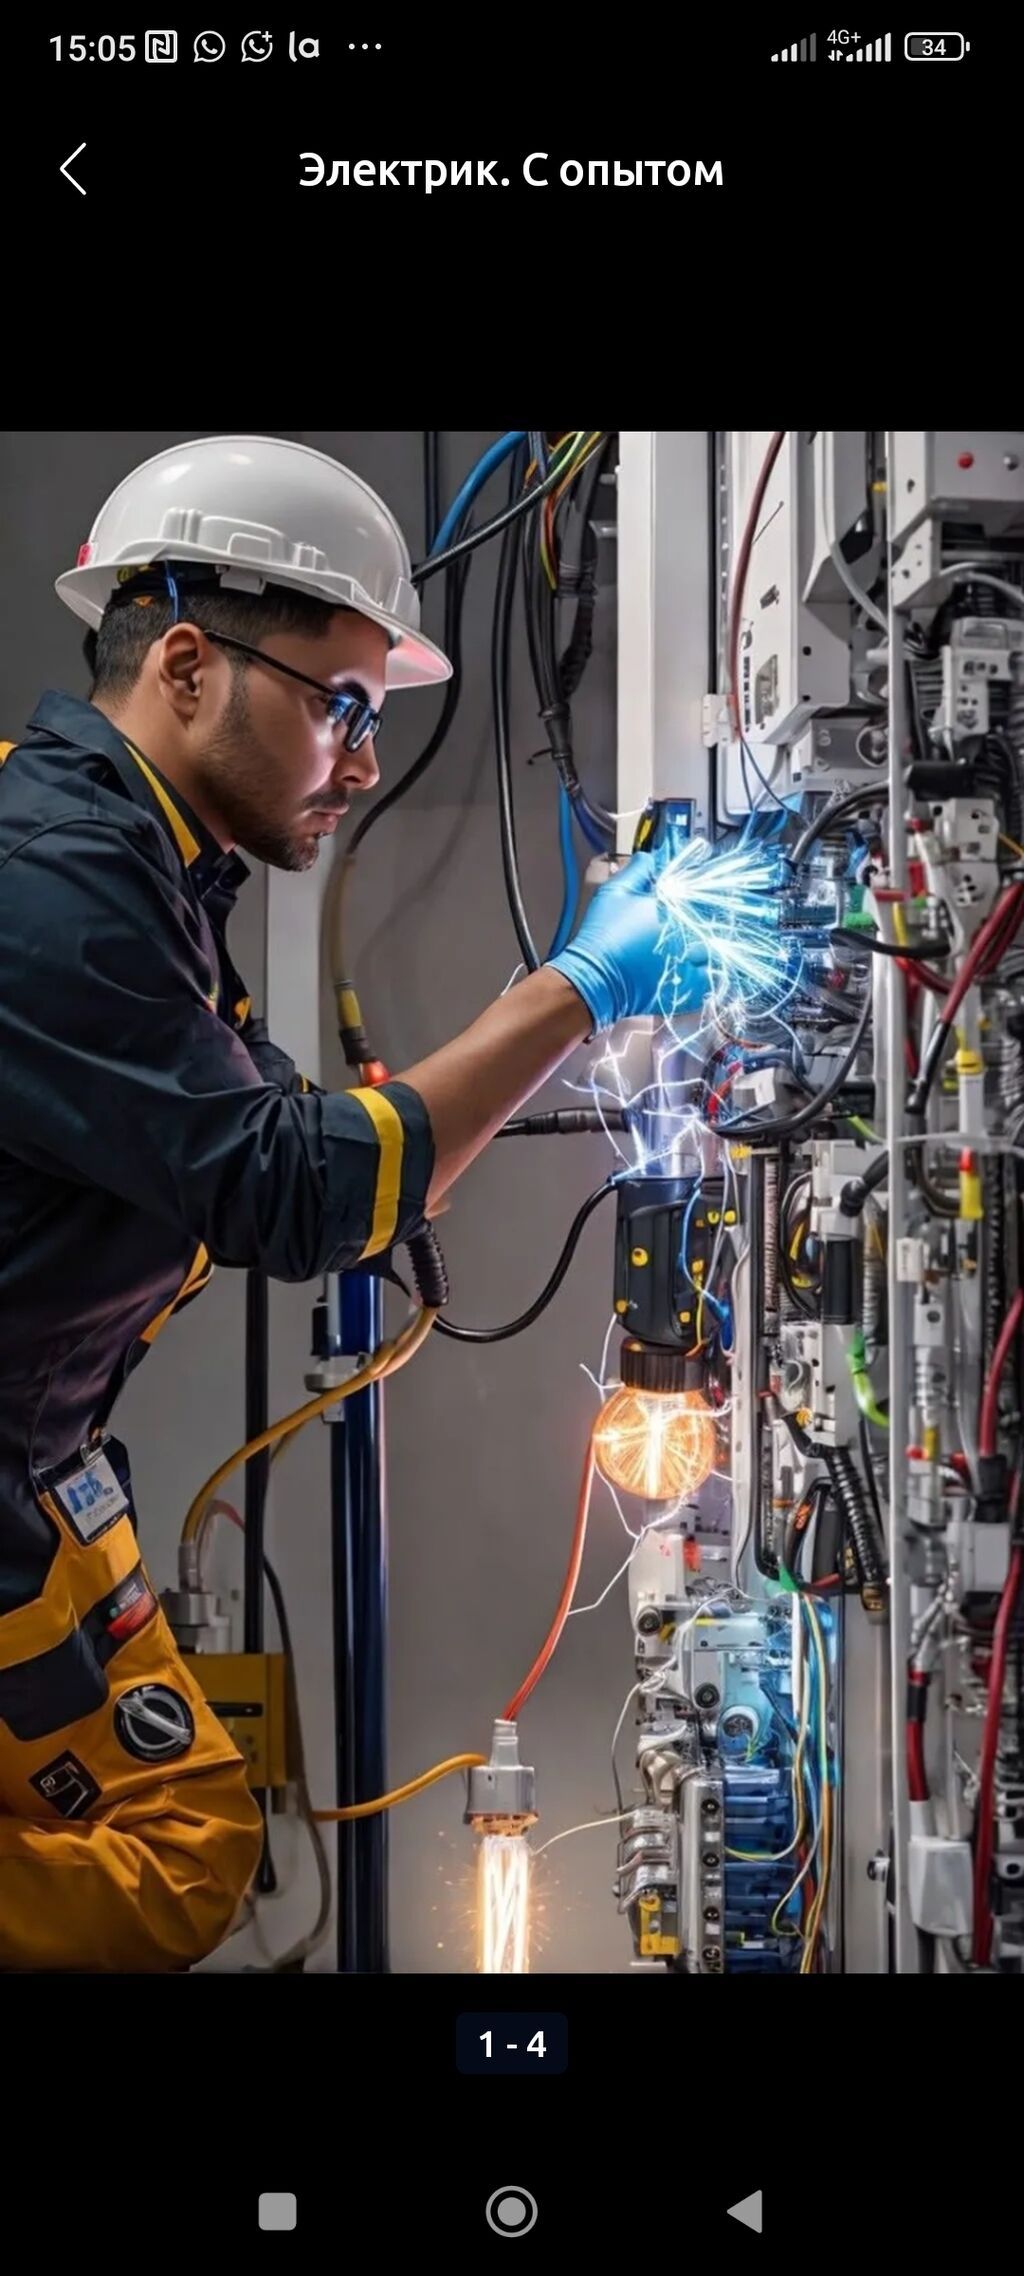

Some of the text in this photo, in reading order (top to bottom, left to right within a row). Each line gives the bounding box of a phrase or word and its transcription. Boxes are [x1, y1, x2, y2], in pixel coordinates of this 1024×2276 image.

[49, 34, 136, 62] 15:05
[826, 29, 862, 45] 4G+
[922, 38, 947, 56] 34
[299, 152, 724, 195] Электрик. С опытом
[479, 2030, 492, 2058] 1
[526, 2030, 547, 2058] 4
